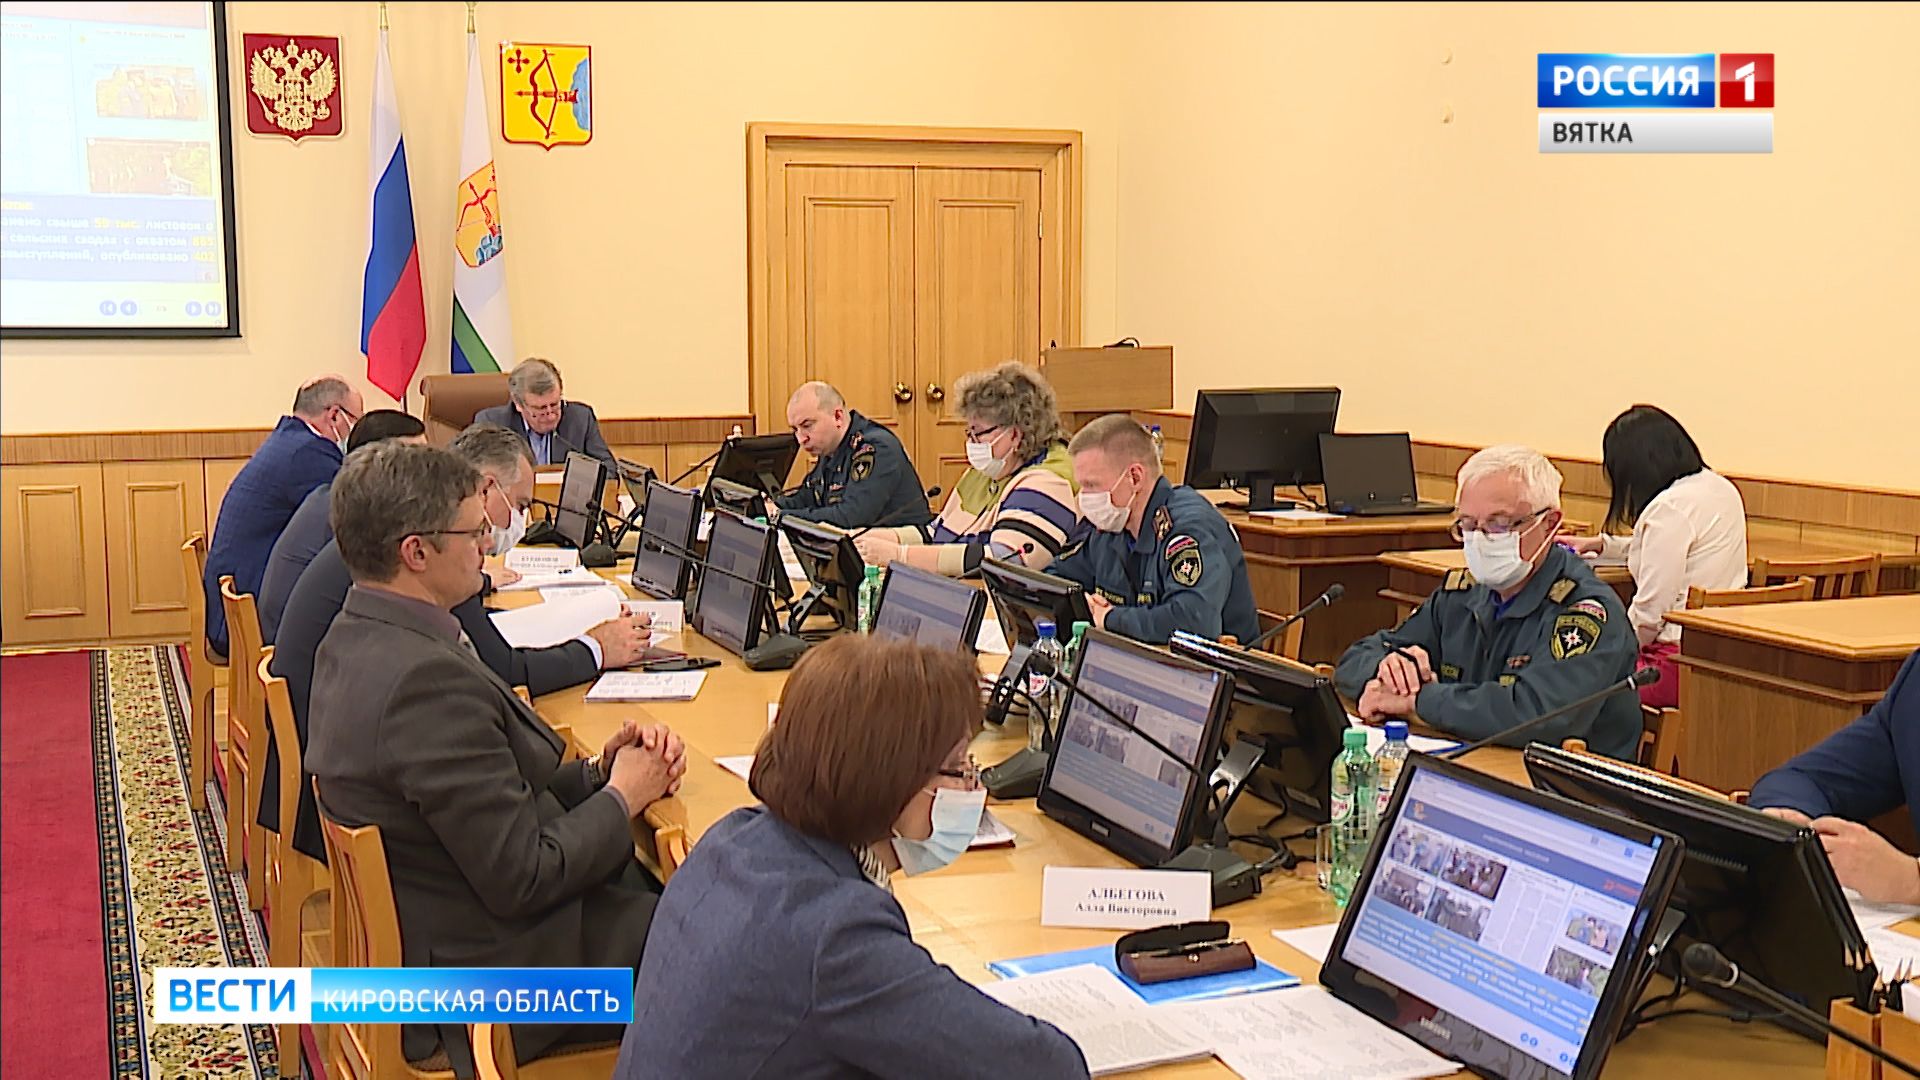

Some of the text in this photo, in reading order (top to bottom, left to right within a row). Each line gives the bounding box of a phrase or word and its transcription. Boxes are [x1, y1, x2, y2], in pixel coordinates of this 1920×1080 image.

[145, 220, 201, 231] листовок
[135, 237, 187, 247] охватом
[100, 249, 189, 263] опубликовано
[1087, 888, 1165, 901] АЛБЕГОВА
[1075, 903, 1177, 917] Алла Викторовна
